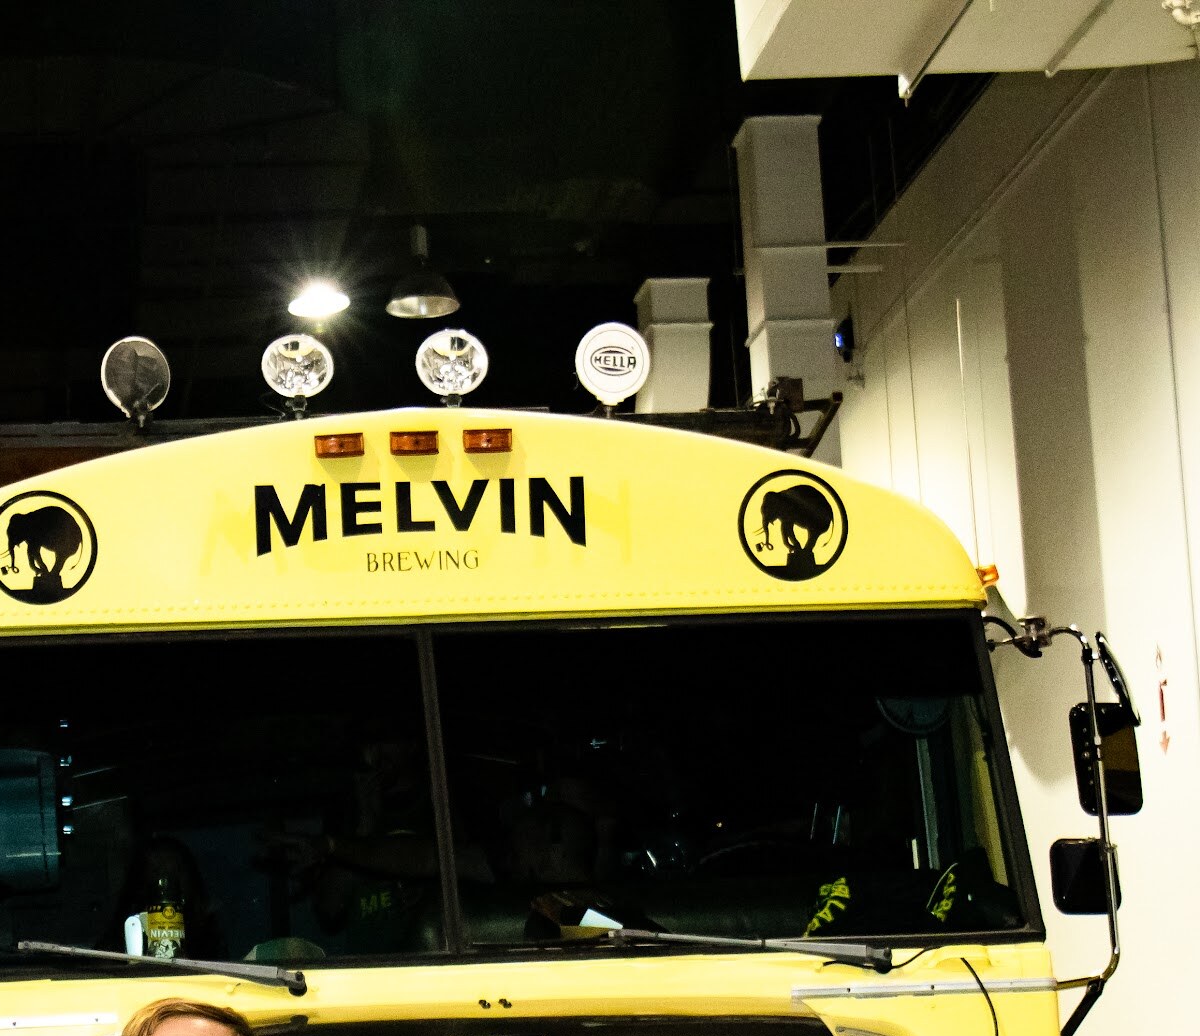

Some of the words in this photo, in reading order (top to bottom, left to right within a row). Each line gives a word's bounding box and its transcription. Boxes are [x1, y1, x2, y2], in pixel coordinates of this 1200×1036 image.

[594, 355, 637, 370] HELLA
[254, 476, 587, 557] MELVIN
[366, 549, 480, 573] BREWING
